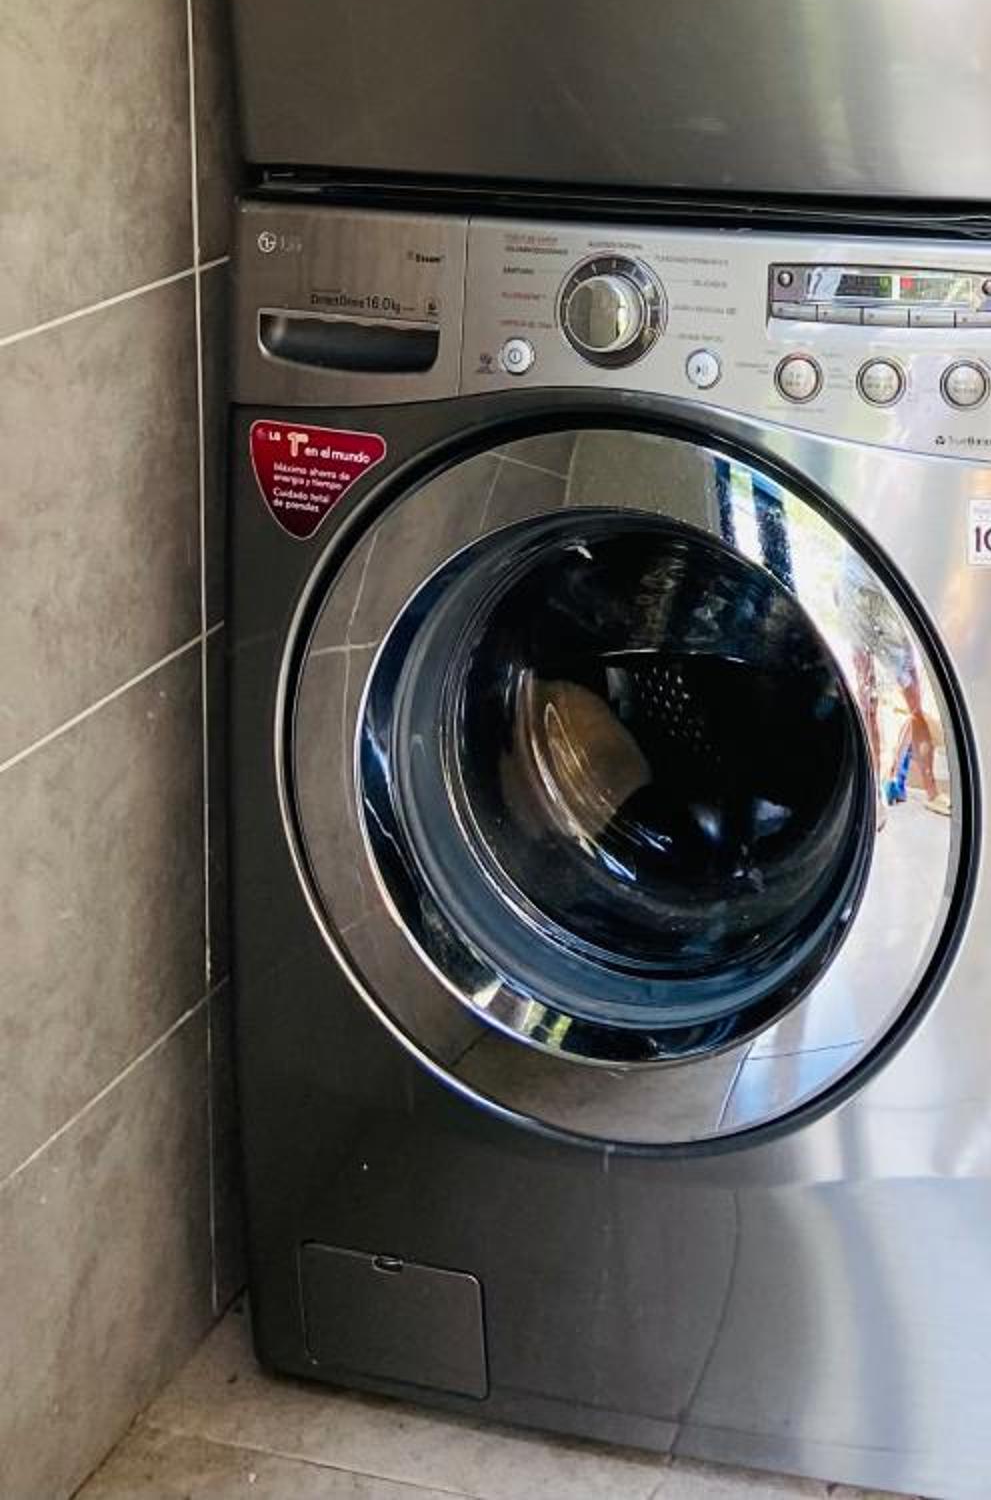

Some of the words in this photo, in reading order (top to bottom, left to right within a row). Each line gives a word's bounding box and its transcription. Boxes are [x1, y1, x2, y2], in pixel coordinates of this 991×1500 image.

[304, 446, 319, 457] en
[319, 446, 331, 459] el
[331, 450, 370, 465] mundo
[273, 486, 308, 501] Cuidado
